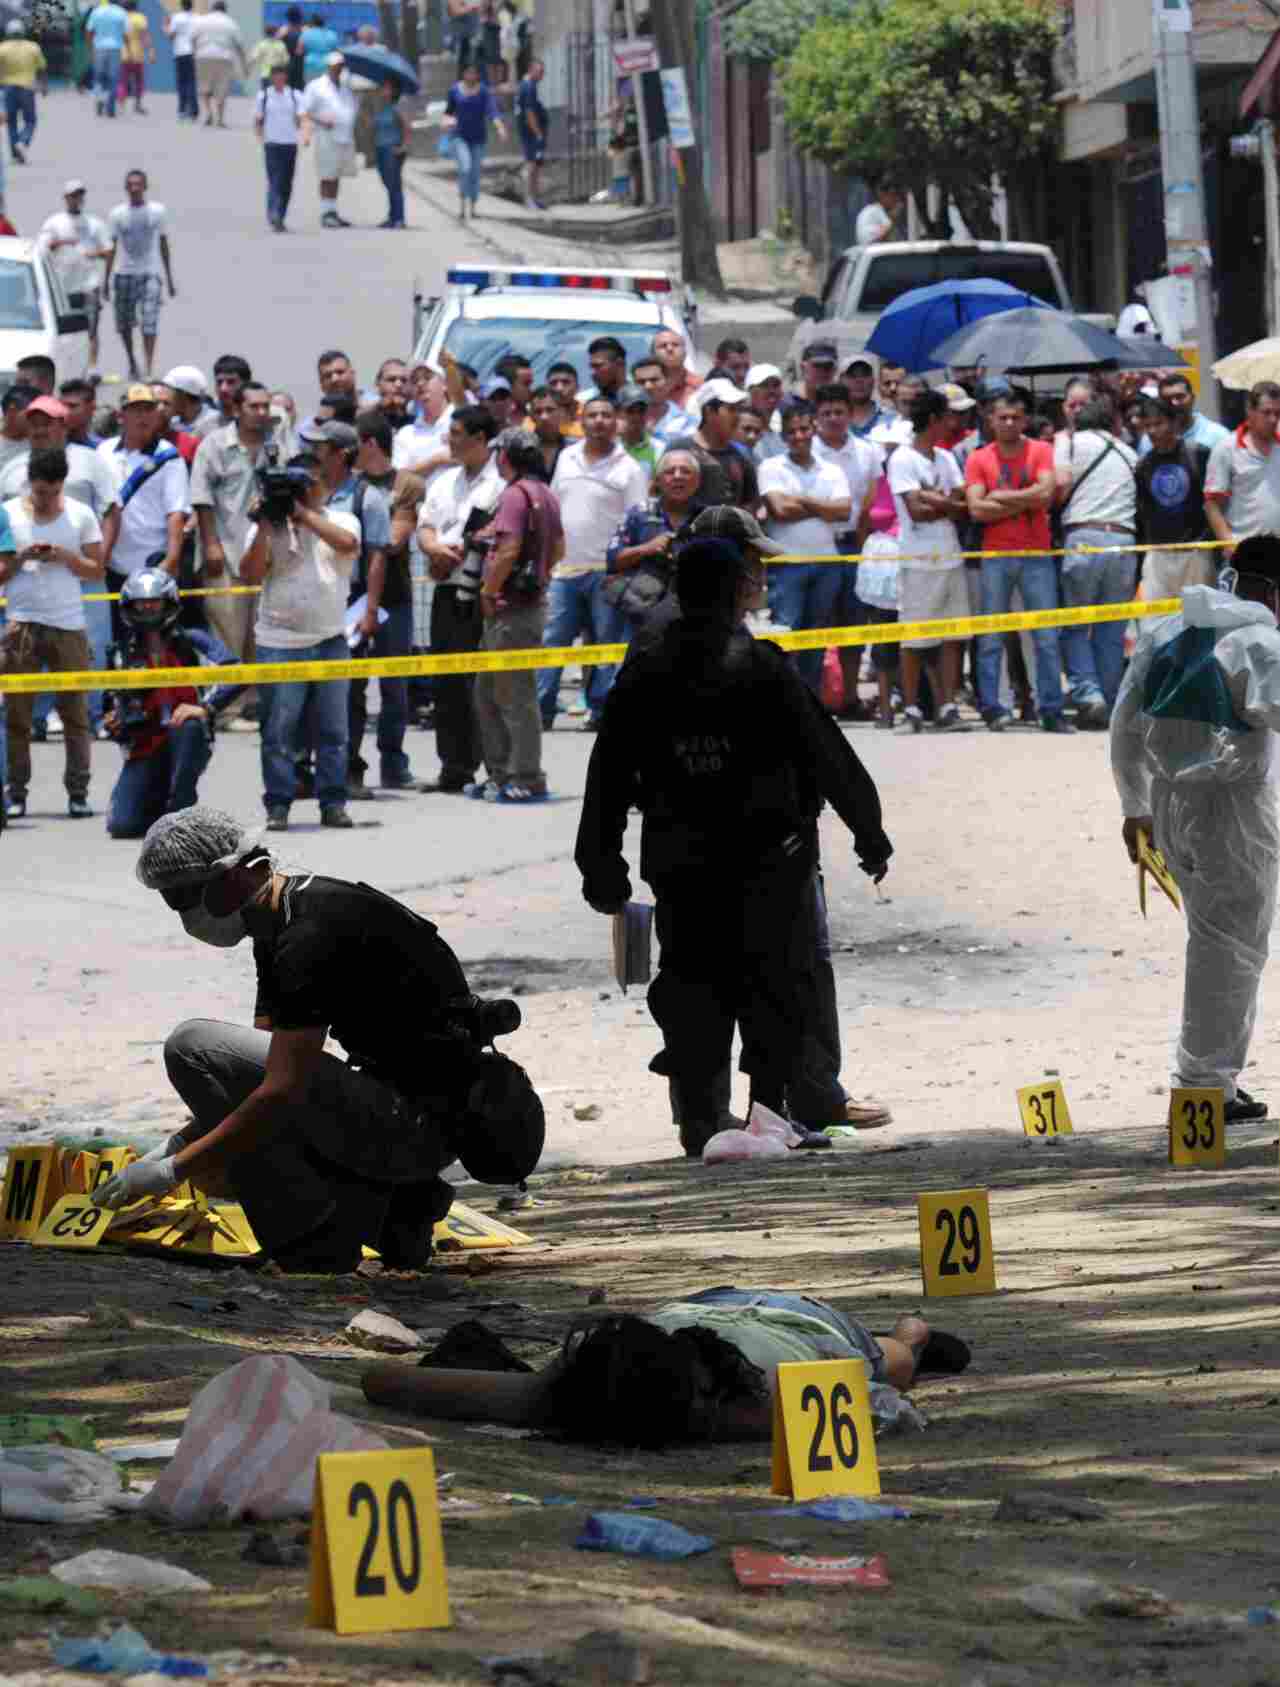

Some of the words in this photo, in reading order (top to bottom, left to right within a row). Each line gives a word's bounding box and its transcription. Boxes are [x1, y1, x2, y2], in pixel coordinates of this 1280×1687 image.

[1029, 1090, 1059, 1135] 37
[1182, 1100, 1216, 1151] 33
[936, 1206, 980, 1277] 29
[801, 1383, 859, 1472] 26
[349, 1480, 422, 1597] 20
